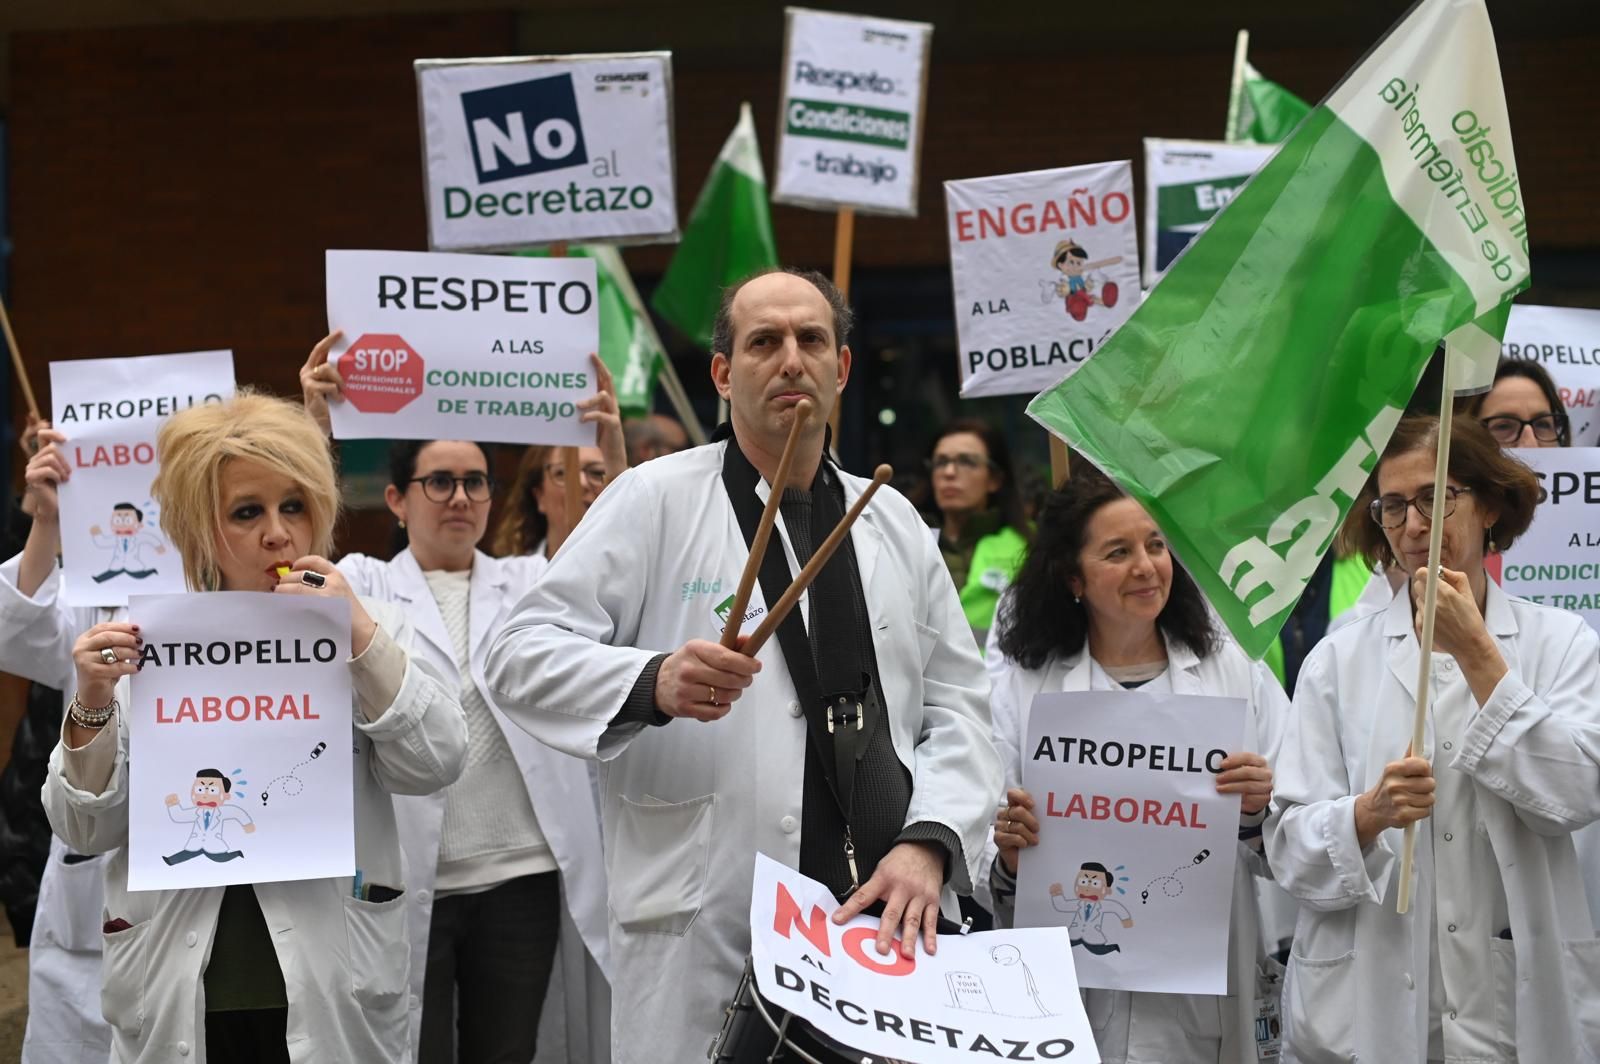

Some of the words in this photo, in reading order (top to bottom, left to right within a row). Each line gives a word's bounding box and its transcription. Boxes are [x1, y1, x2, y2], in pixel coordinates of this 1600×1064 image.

[795, 61, 894, 95] Respeto
[790, 102, 907, 141] Condiciones
[472, 111, 577, 173] No
[592, 150, 620, 178] al
[816, 152, 897, 184] trabajo
[444, 182, 653, 219] Decretazo
[955, 188, 1130, 242] ENGAÑO
[378, 275, 592, 315] RESPETO
[971, 302, 984, 317] A
[988, 298, 1010, 315] LA
[355, 348, 409, 372] STOP
[491, 340, 504, 353] A
[510, 340, 544, 354] LAS
[968, 331, 1110, 374] POBLACI
[348, 374, 405, 385] AGRESIONES
[406, 377, 413, 385] A
[426, 370, 587, 389] CONDICIONES
[437, 399, 467, 414] DE
[474, 401, 575, 422] TRABAJO
[75, 443, 159, 469] LABO
[1568, 533, 1580, 547] A
[682, 578, 723, 594] salud
[139, 638, 337, 667] ATROPELLO
[156, 694, 320, 723] LABORAL
[1033, 736, 1229, 774] ATROPELLO
[1046, 792, 1207, 829] LABORAL
[774, 881, 916, 976] NO
[801, 953, 832, 975] AL
[774, 963, 1075, 1061] DECRETAZO
